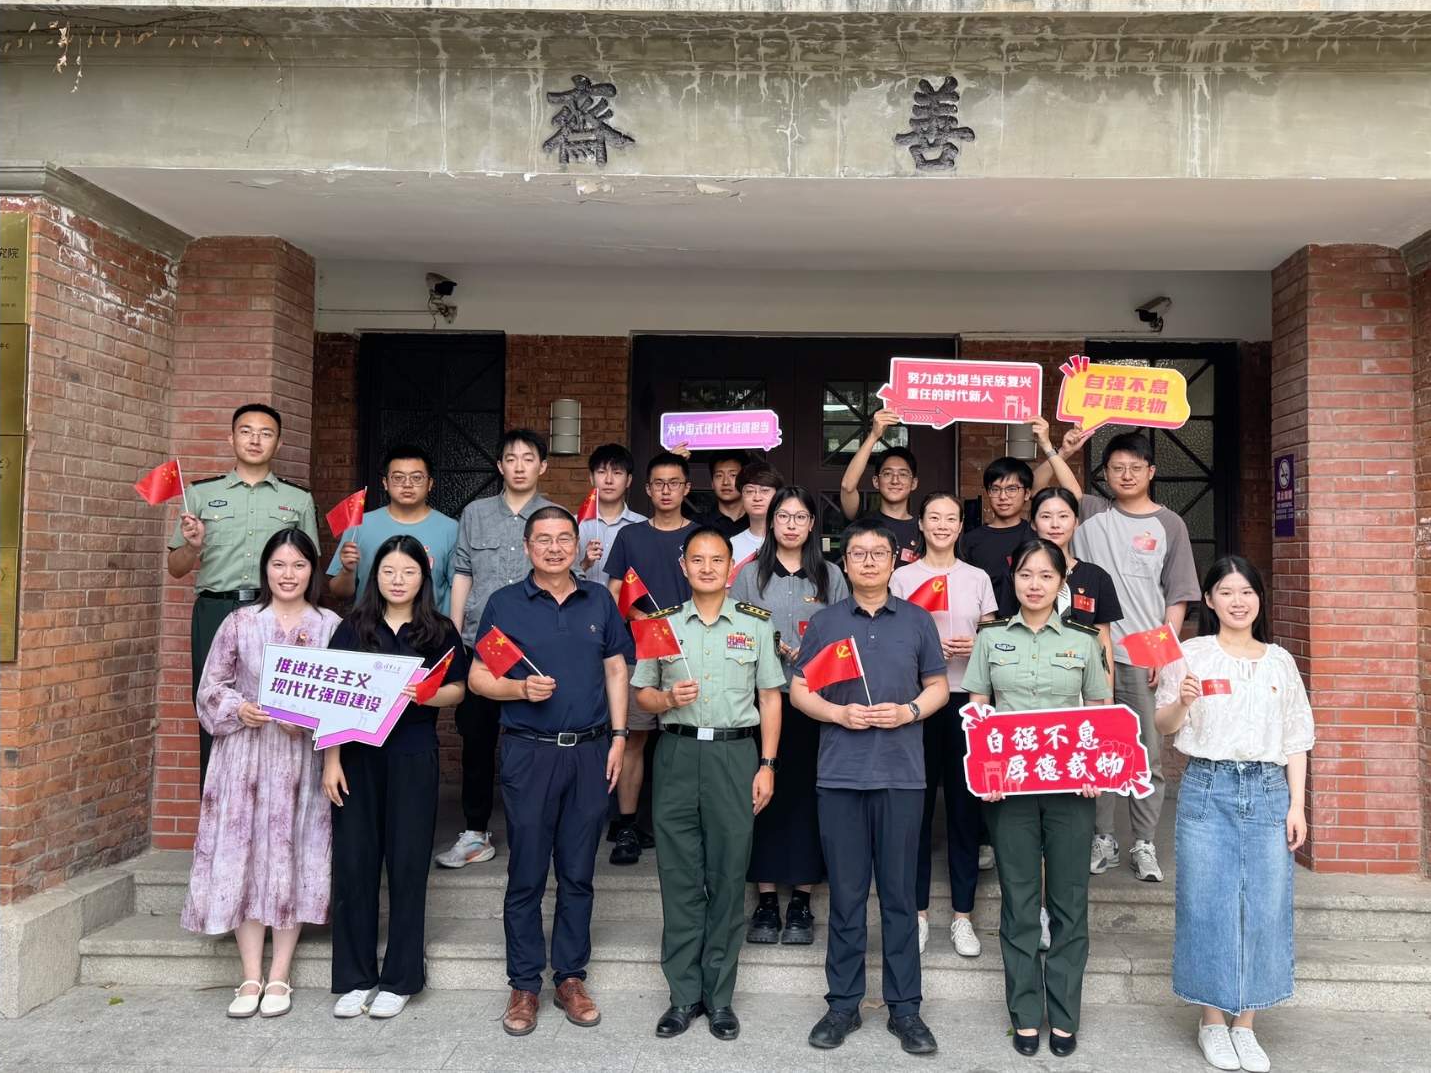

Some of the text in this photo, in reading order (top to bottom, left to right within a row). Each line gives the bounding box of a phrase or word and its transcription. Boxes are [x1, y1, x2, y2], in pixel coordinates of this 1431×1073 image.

[907, 371, 1032, 388] 努力成为堪当民族复兴
[1084, 374, 1170, 395] 自强不息
[907, 388, 993, 403] 重任的时代新人
[1082, 392, 1168, 414] 厚德载物
[274, 656, 372, 690] 推进社会主义
[269, 677, 382, 713] 现代化强国建设
[986, 719, 1100, 754] 自强不息
[1004, 751, 1125, 784] 厚德载物
